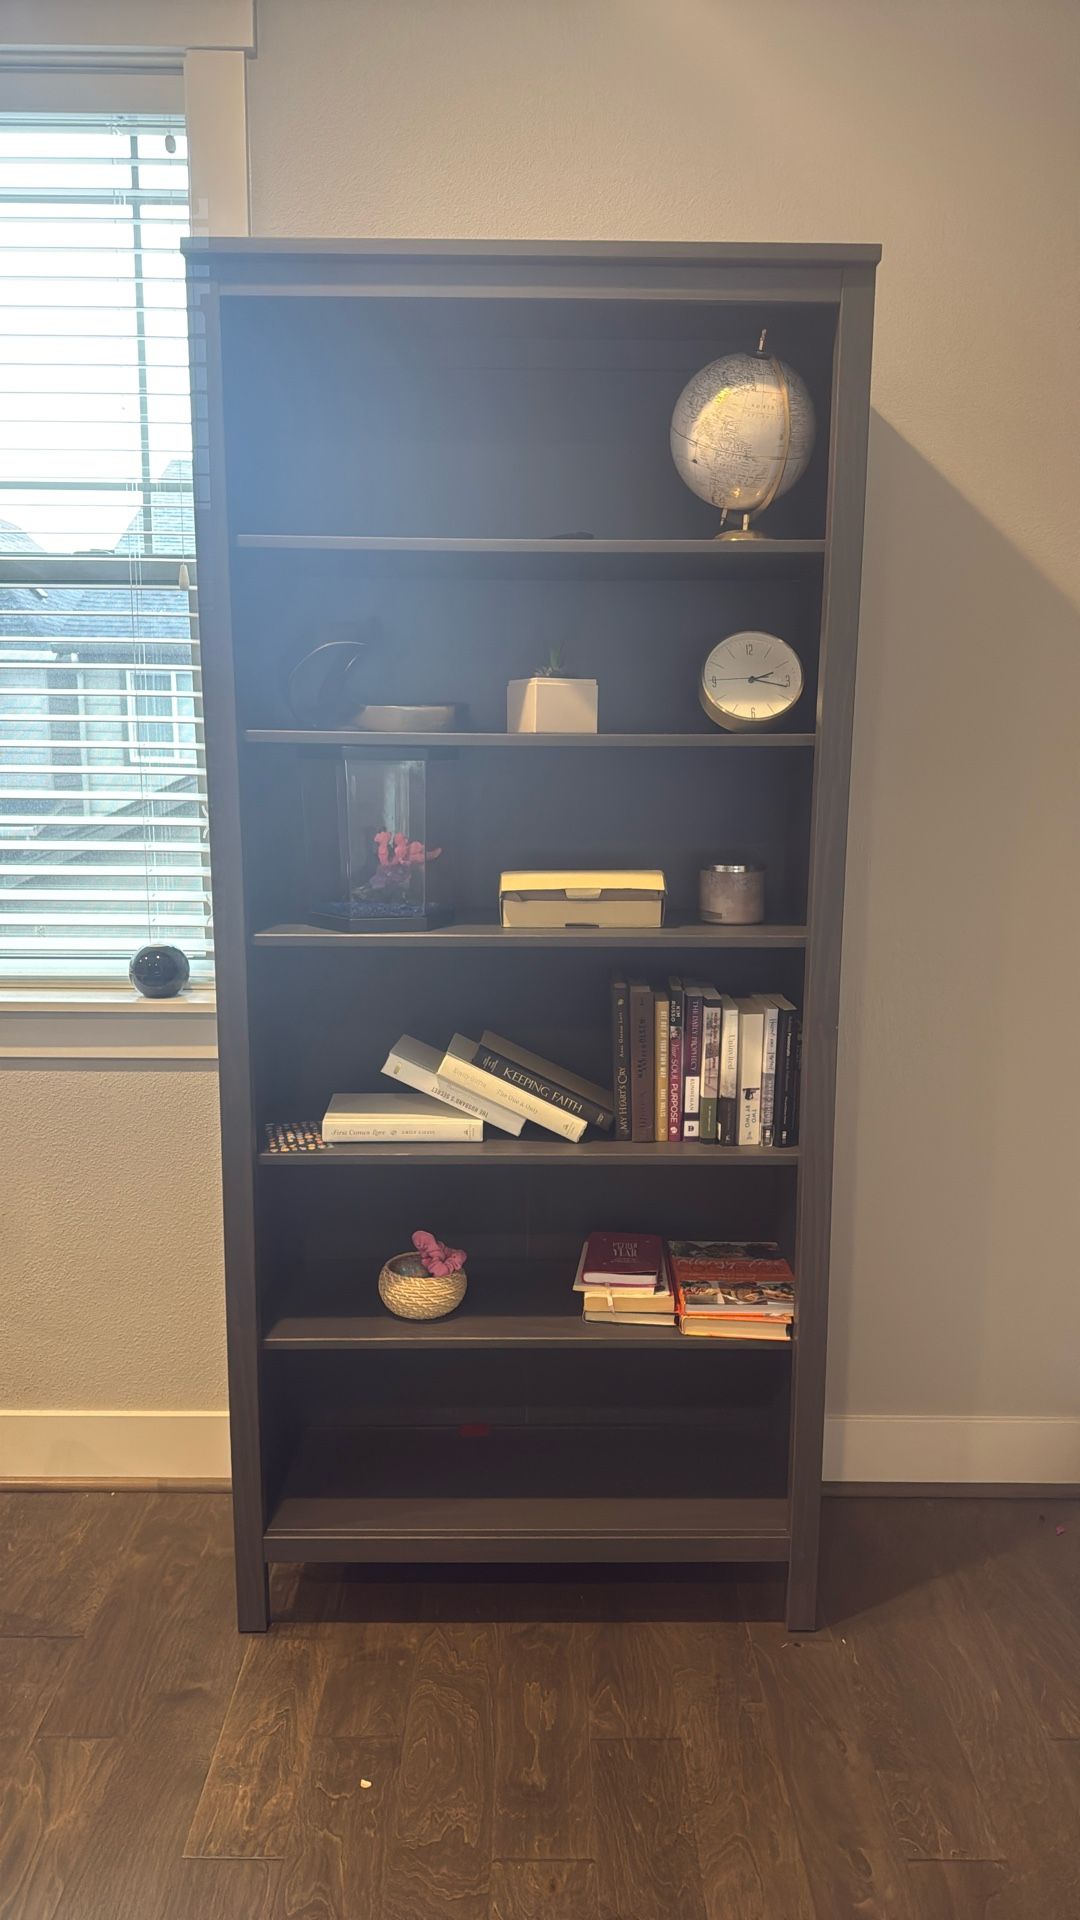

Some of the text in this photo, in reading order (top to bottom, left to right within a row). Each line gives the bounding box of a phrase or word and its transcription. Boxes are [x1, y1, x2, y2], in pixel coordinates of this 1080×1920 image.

[745, 643, 753, 656] 12
[712, 676, 717, 688] 9
[785, 674, 791, 688] 3
[750, 707, 756, 719] 6
[690, 1001, 699, 1072] THE DAILY PROPHECY
[727, 1033, 736, 1071] Uninvited
[670, 1058, 678, 1080] SOUL
[430, 1086, 450, 1101] SECRET
[502, 1066, 550, 1098] KEEPING
[550, 1090, 584, 1114] FAITH
[617, 1066, 628, 1130] MY HEART'S CRY
[450, 1094, 479, 1114] HUSBAND'S
[670, 1083, 678, 1123] PURPOSE
[745, 1105, 751, 1113] BY
[480, 1109, 490, 1119] THE
